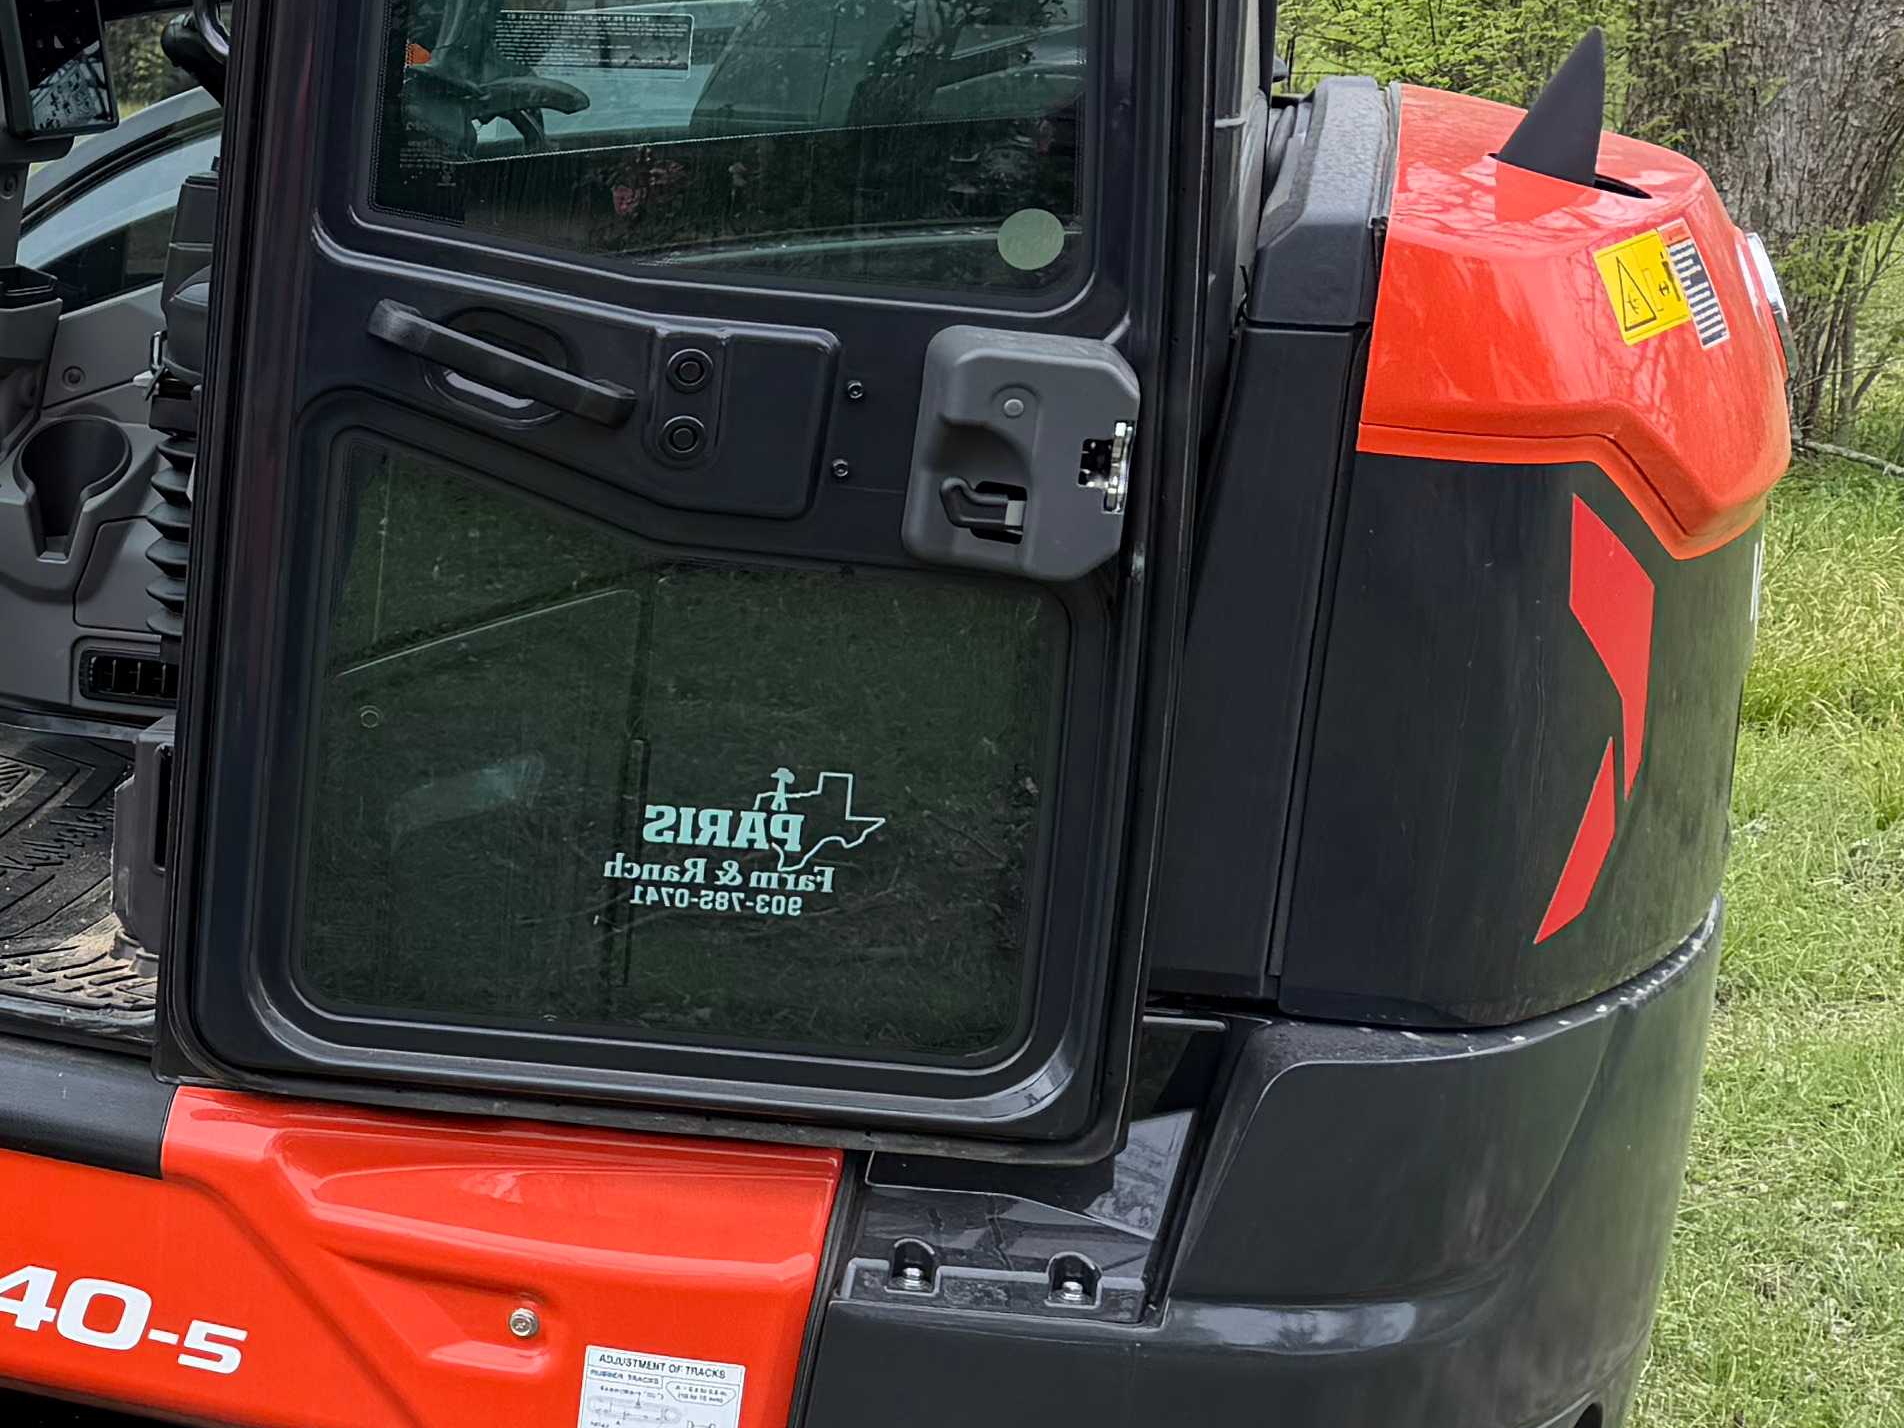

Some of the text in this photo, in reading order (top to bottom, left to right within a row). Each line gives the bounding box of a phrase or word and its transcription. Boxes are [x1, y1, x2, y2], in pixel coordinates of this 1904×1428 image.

[599, 1354, 726, 1380] ADJUSTMENT OF TRACKS
